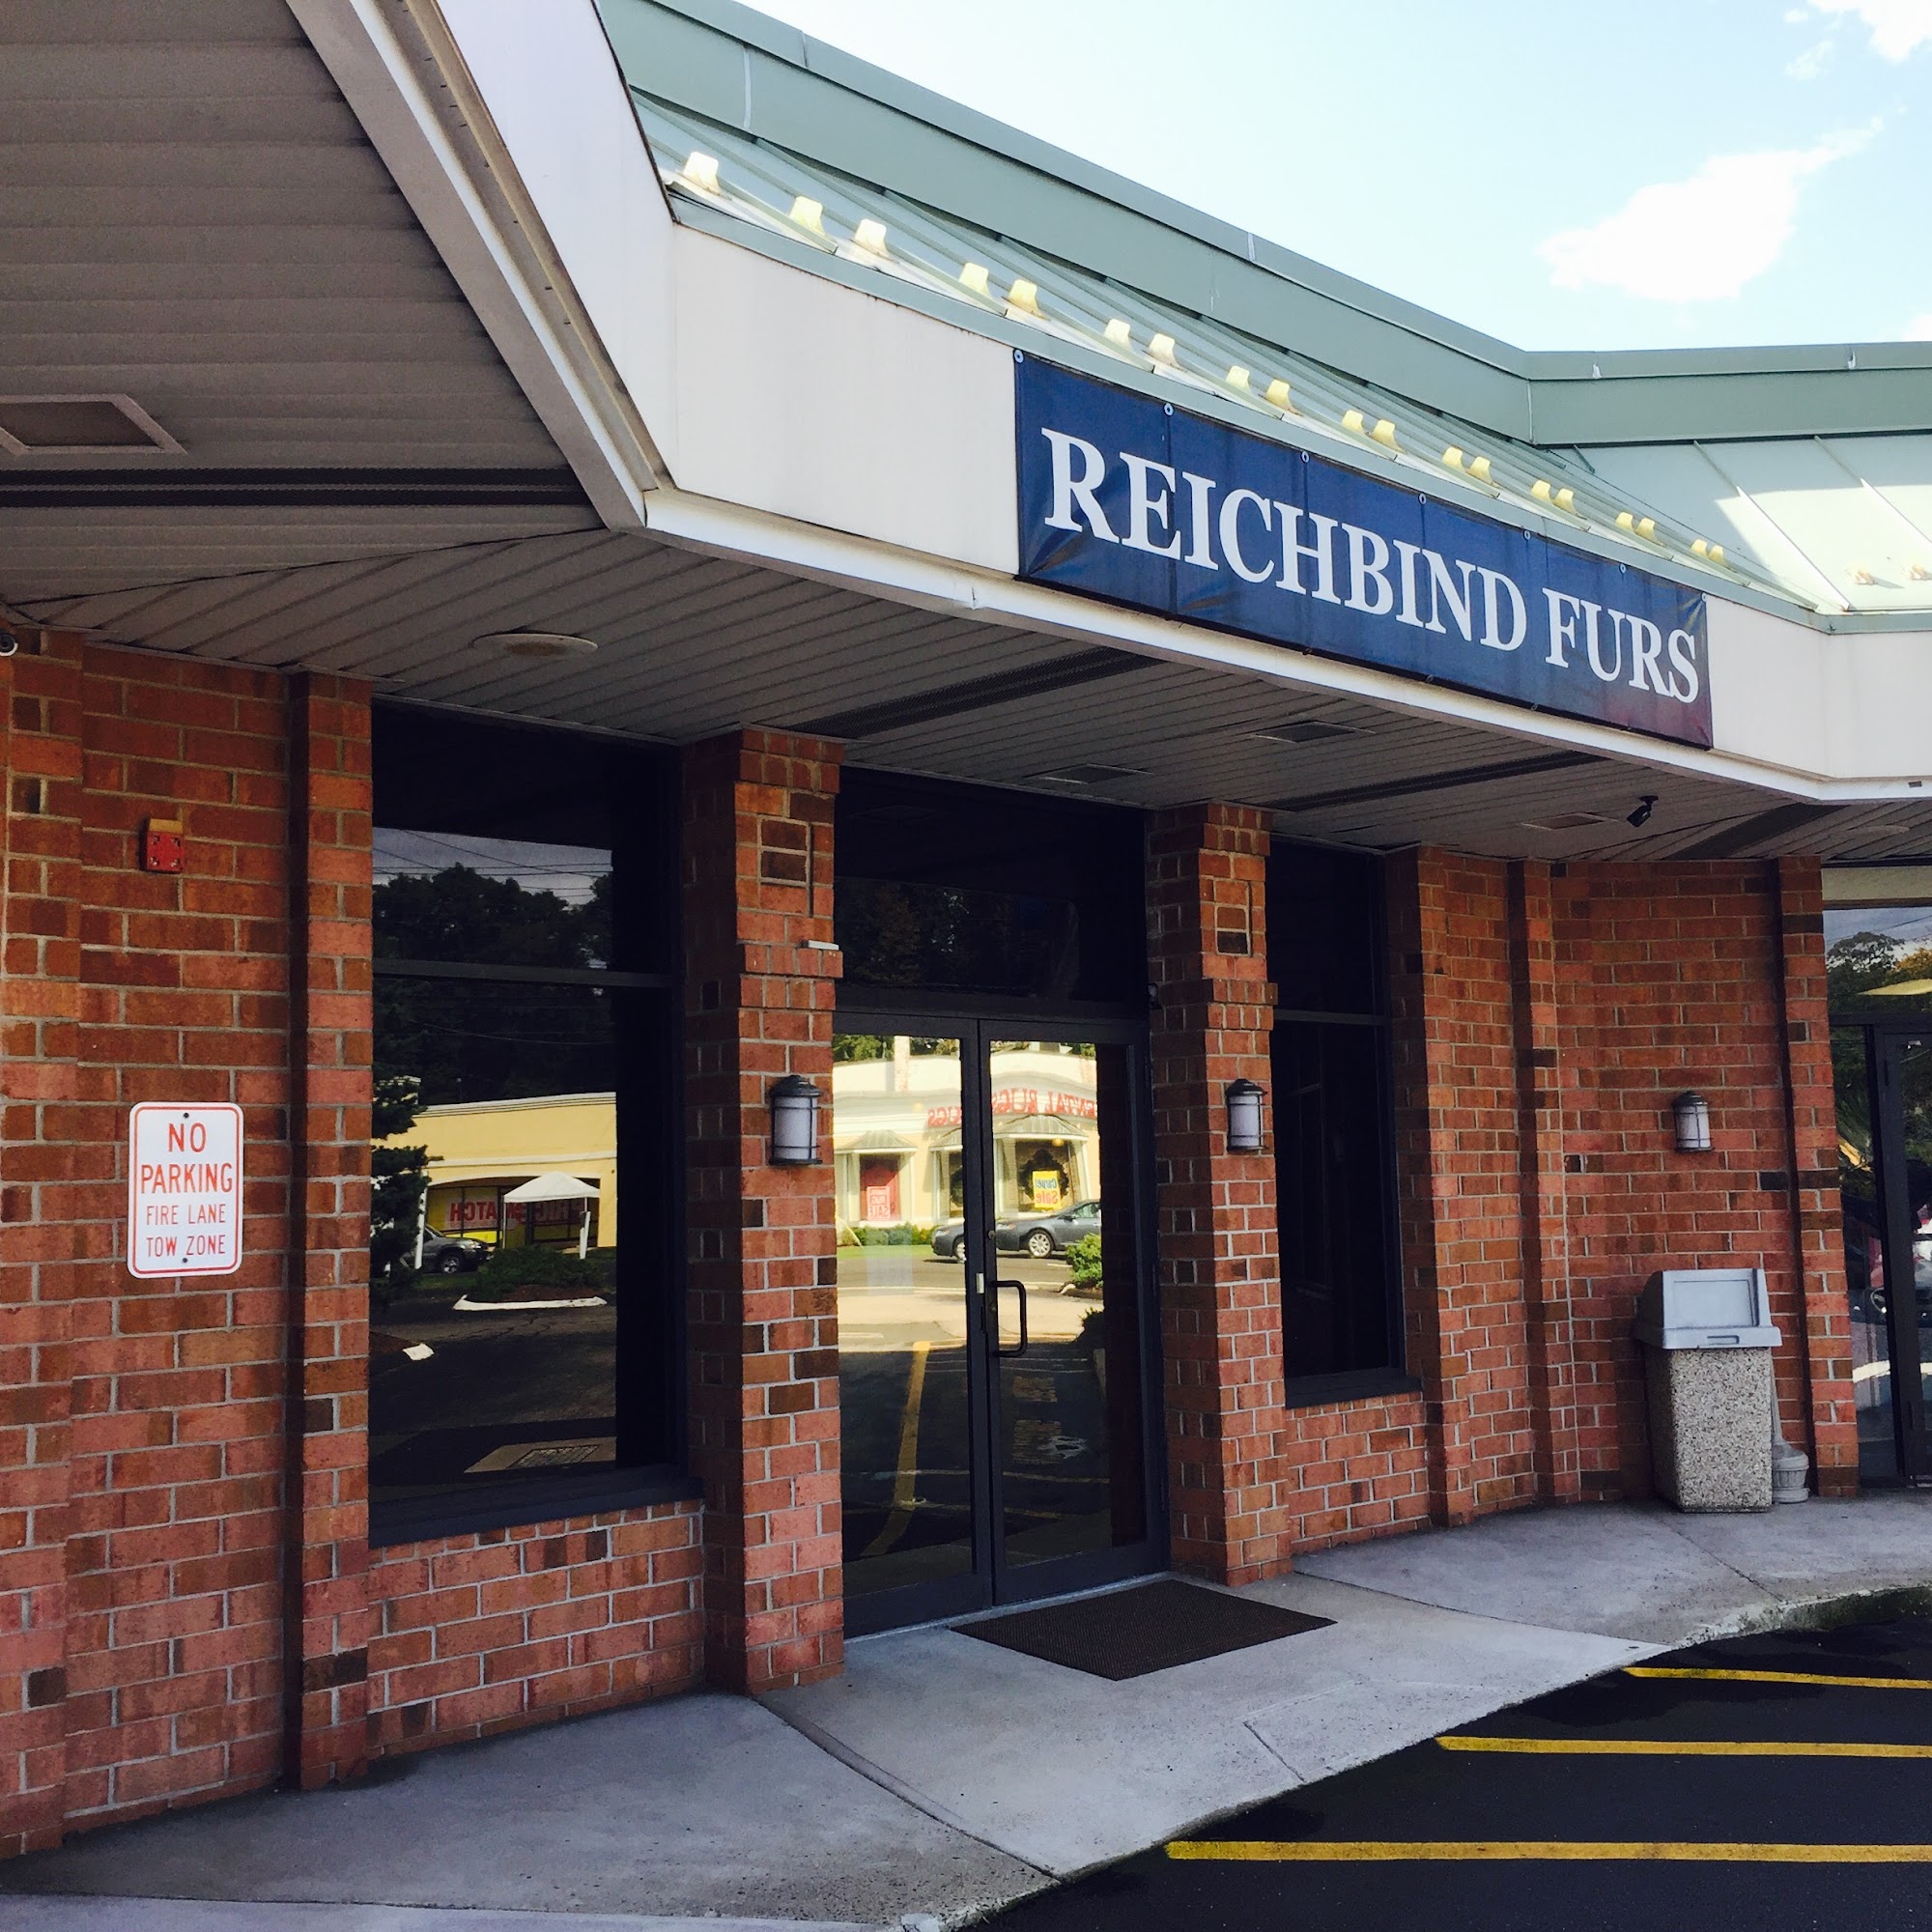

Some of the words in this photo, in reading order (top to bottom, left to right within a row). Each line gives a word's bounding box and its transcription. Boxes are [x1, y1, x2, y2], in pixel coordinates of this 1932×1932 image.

[1040, 427, 1527, 652] REICHBIND
[1542, 587, 1700, 704] FURS
[168, 1122, 207, 1153] NO
[140, 1162, 233, 1194] PARKING
[146, 1205, 179, 1226] FIRE
[187, 1204, 226, 1225] LANE
[146, 1236, 178, 1257] TOW
[186, 1235, 226, 1256] ZONE
